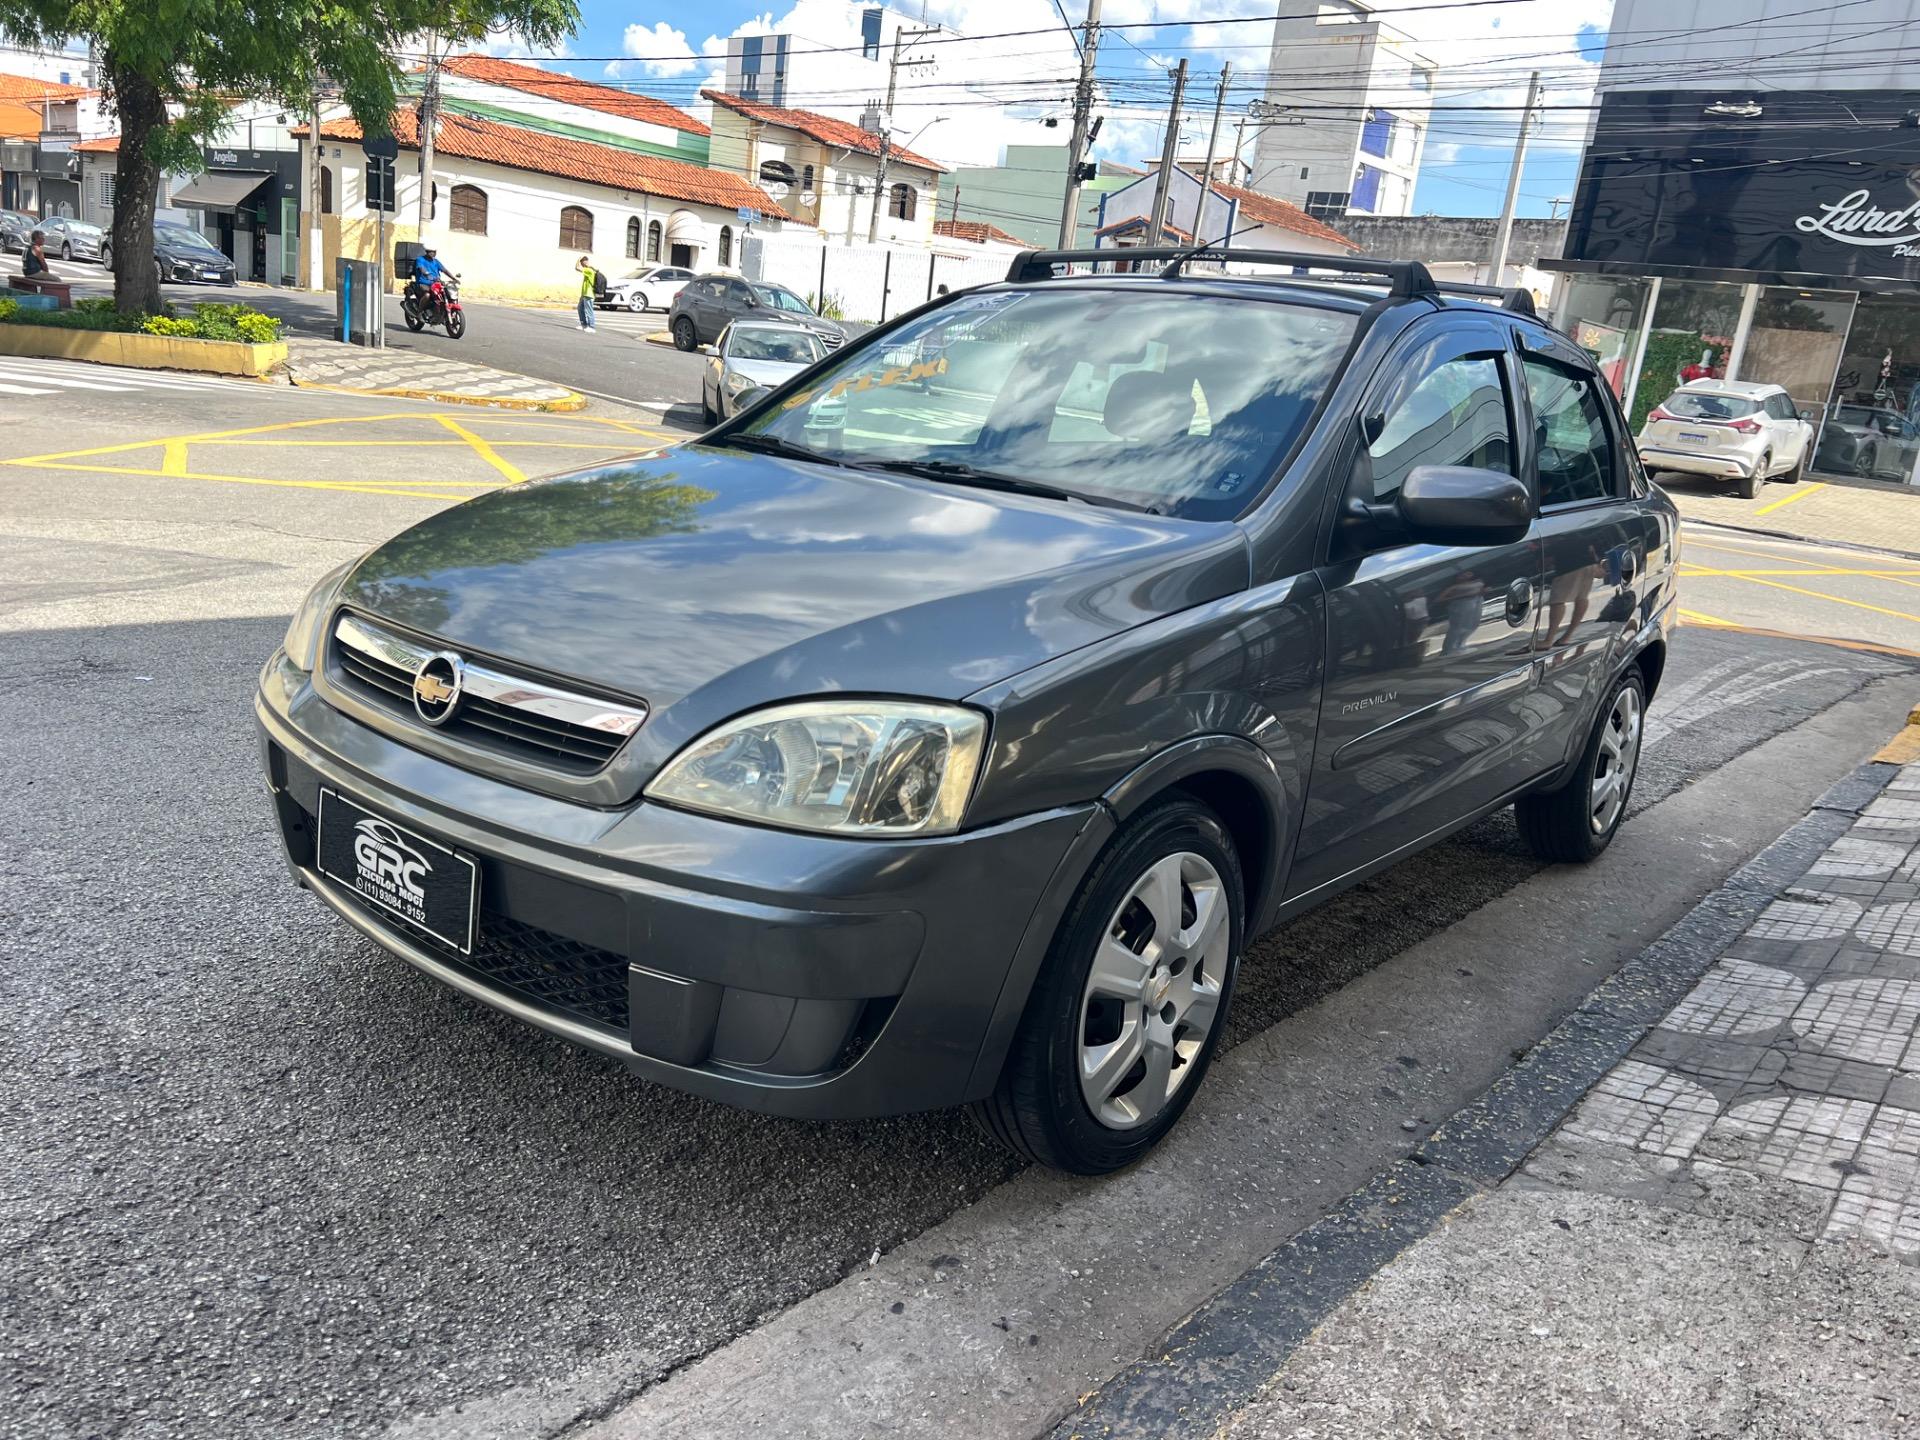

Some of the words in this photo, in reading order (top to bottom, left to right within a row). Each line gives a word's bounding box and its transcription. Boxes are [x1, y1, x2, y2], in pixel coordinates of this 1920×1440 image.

[1342, 691, 1398, 715] PREMIUM
[355, 834, 425, 898] GRC
[356, 863, 396, 893] VEICULOS
[398, 886, 424, 909] MOGI
[364, 880, 379, 900] (11)
[379, 888, 402, 910] 93084
[406, 904, 426, 924] 9152
